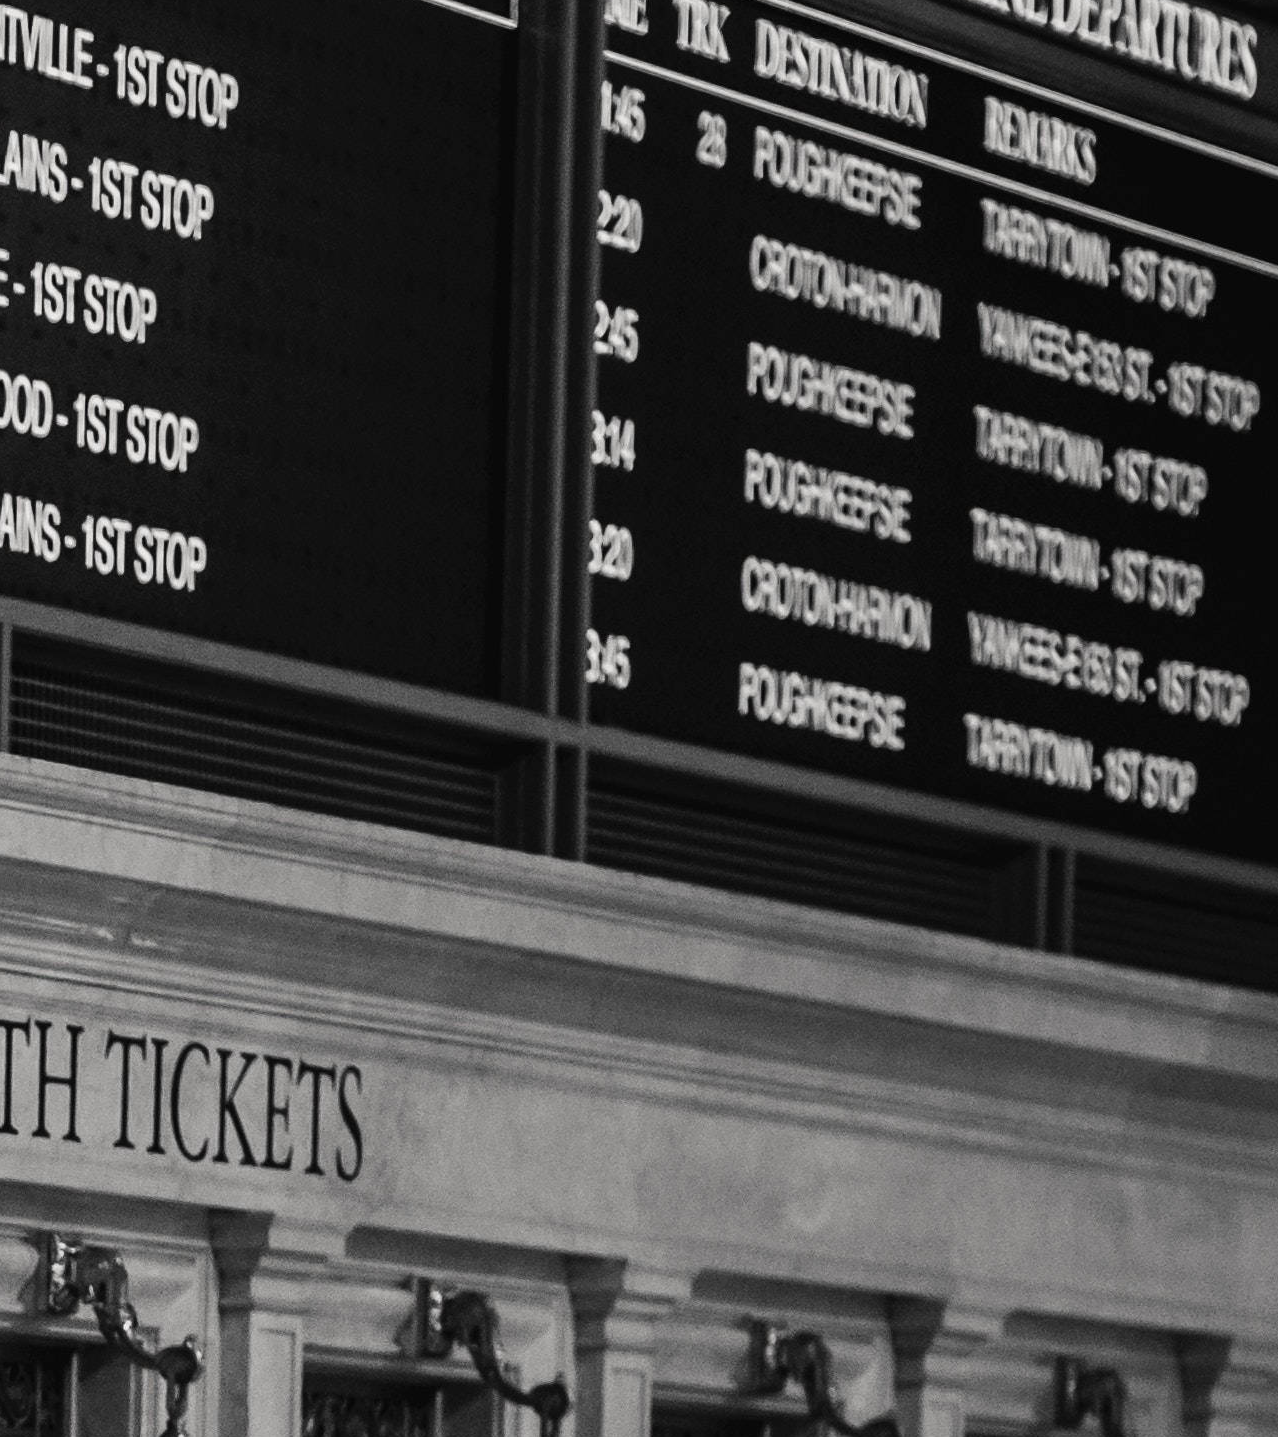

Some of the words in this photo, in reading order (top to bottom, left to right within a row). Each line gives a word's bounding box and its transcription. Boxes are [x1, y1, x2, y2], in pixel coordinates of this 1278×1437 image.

[97, 65, 109, 75] -
[114, 45, 164, 106] 1ST
[166, 59, 238, 128] STOP
[754, 19, 929, 128] DESTINATION
[984, 96, 1096, 184] REMARKS
[71, 178, 83, 189] -
[89, 158, 138, 218] 1ST
[141, 171, 213, 239] STOP
[13, 283, 25, 293] -
[31, 262, 81, 323] 1ST
[84, 275, 156, 343] STOP
[57, 415, 68, 426] -
[74, 394, 124, 453] 1ST
[126, 405, 198, 471] STOP
[65, 536, 76, 547] -
[82, 516, 131, 574] 1ST
[134, 526, 206, 591] STOP
[104, 1028, 364, 1183] TICKETS
